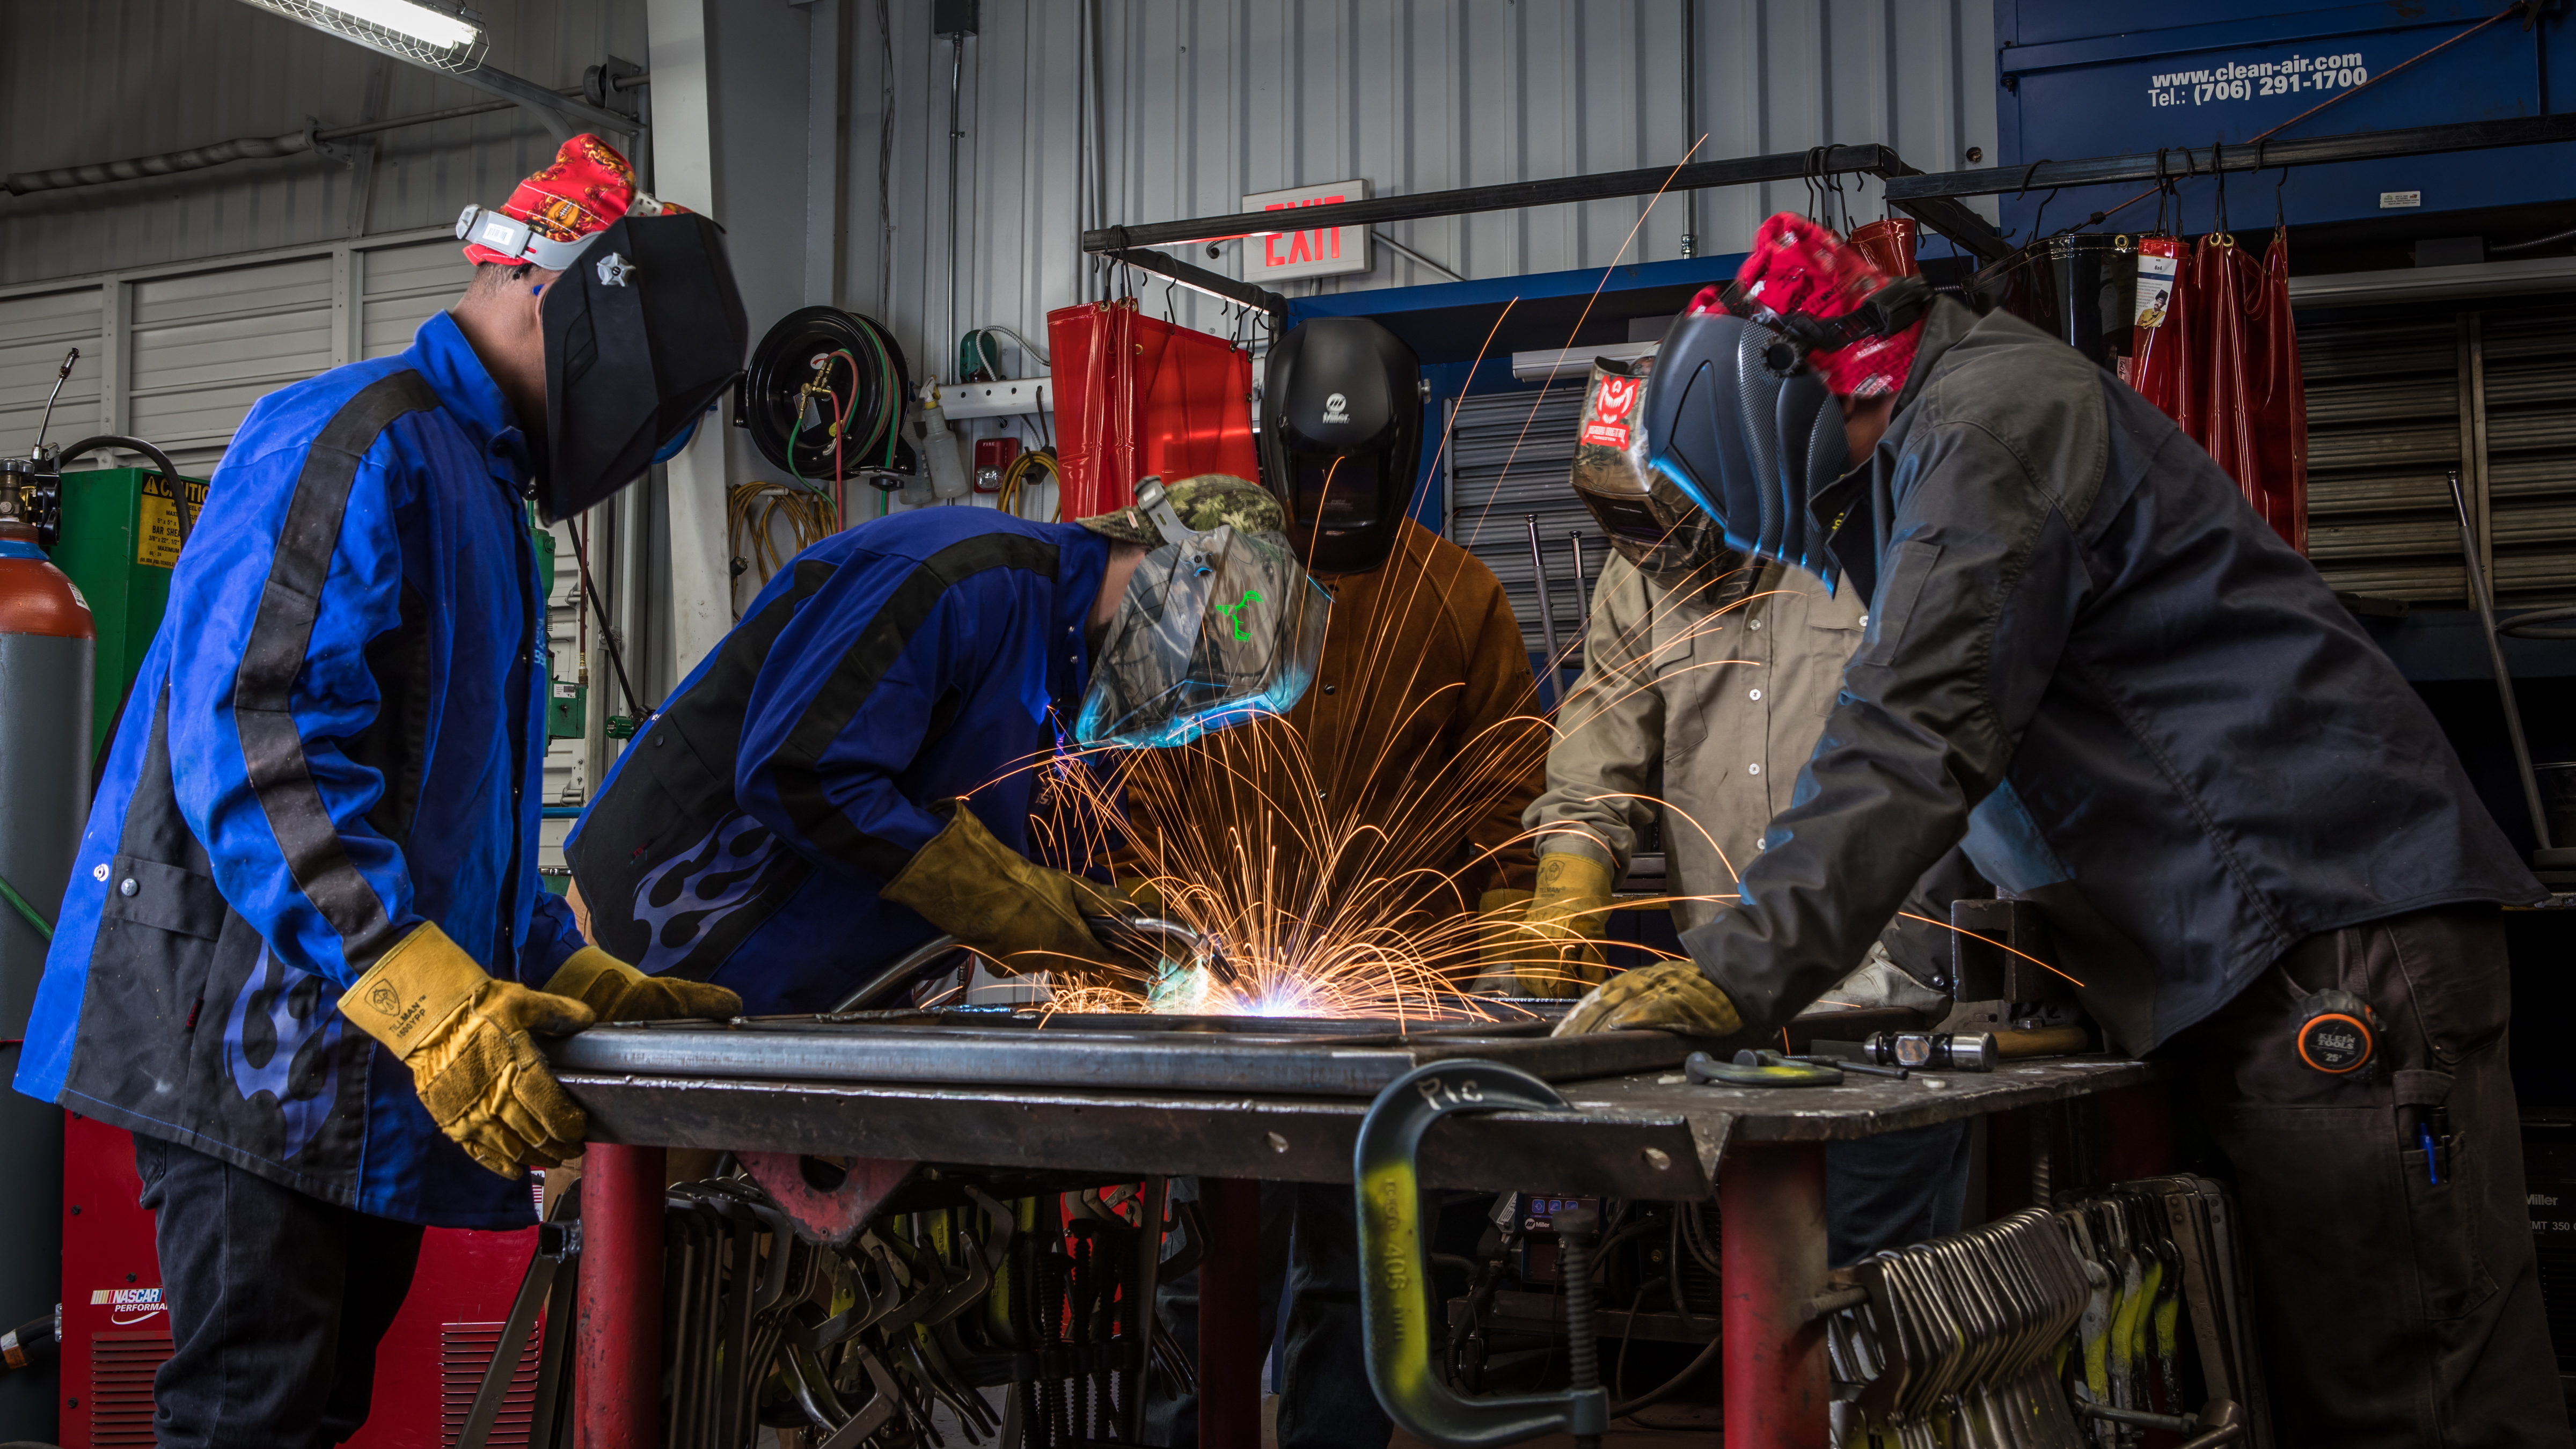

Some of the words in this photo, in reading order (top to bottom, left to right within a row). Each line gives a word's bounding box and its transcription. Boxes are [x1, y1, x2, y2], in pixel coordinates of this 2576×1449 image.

[2152, 53, 2362, 87] www.clean-air.com
[2148, 88, 2185, 107] Tel.:
[2194, 80, 2251, 105] (706)
[2259, 67, 2367, 96] 291-1700
[1265, 195, 1345, 267] EXIT
[160, 478, 211, 503] CUTIO
[152, 525, 164, 535] BAR
[166, 528, 180, 538] SHEA
[157, 545, 179, 554] MAXIMUM
[2318, 1040, 2354, 1049] TOOLS
[2319, 1033, 2356, 1043] KLEIN
[2530, 1221, 2548, 1230] MT
[2552, 1221, 2570, 1231] 350
[112, 1289, 160, 1304] NASCAR
[114, 1302, 167, 1313] PERFORMA
